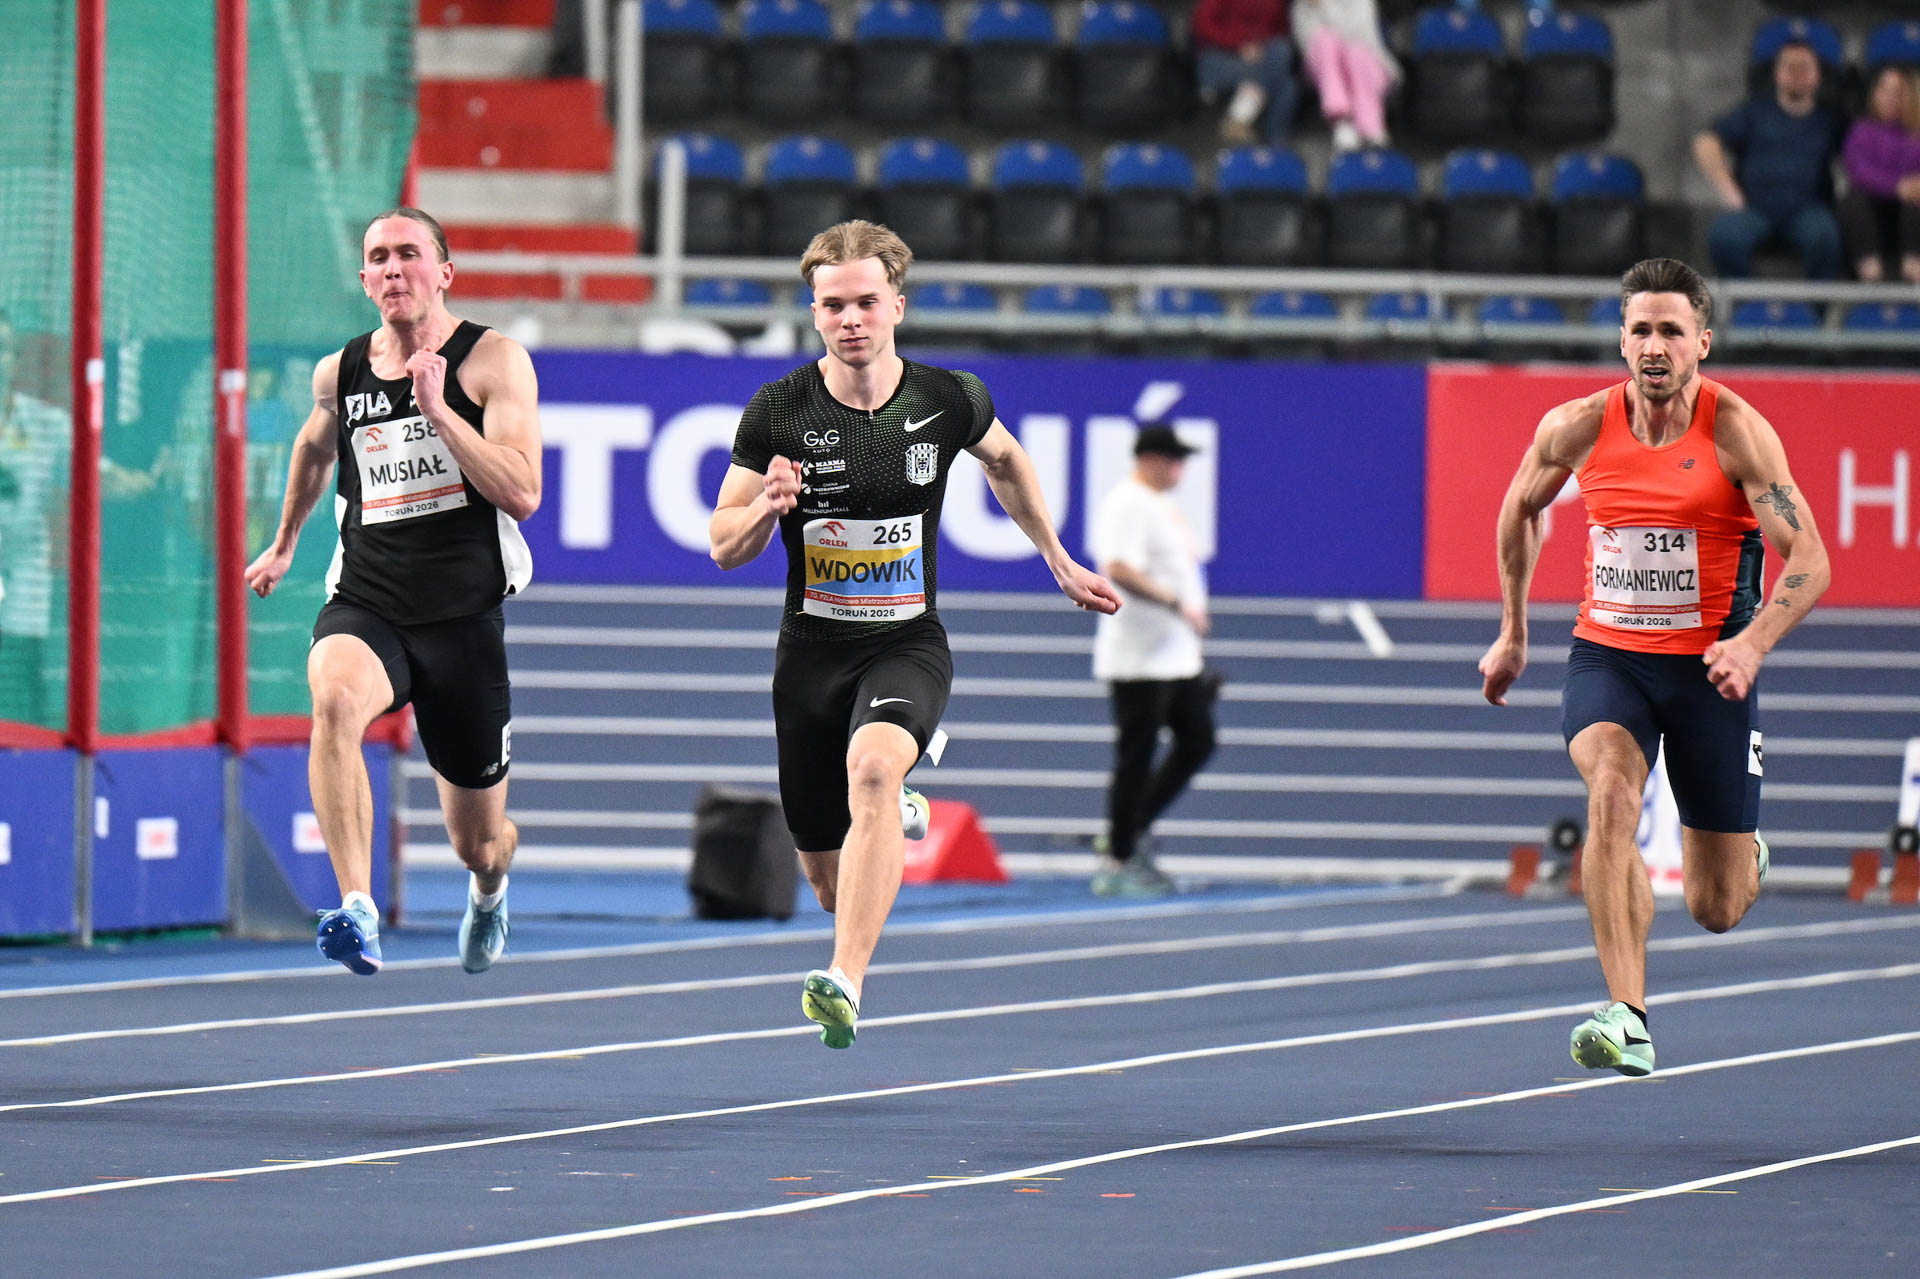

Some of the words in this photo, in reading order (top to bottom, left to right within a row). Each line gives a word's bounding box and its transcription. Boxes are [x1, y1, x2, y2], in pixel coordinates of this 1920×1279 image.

[803, 430, 840, 446] G&G
[369, 455, 447, 487] MUSIAŁ
[540, 379, 1217, 562] TOUŃ
[385, 504, 413, 517] TORUŃ
[416, 501, 439, 512] 2026
[818, 538, 848, 548] ORLEN
[873, 522, 911, 545] 265
[1644, 532, 1686, 553] 314
[811, 557, 917, 583] WDOWIK
[1595, 565, 1695, 592] FORMANIEWICZ
[831, 607, 867, 617] TORUŃ
[870, 609, 895, 617] 2026
[1613, 616, 1644, 625] TORUŃ
[1646, 617, 1672, 626] 2026
